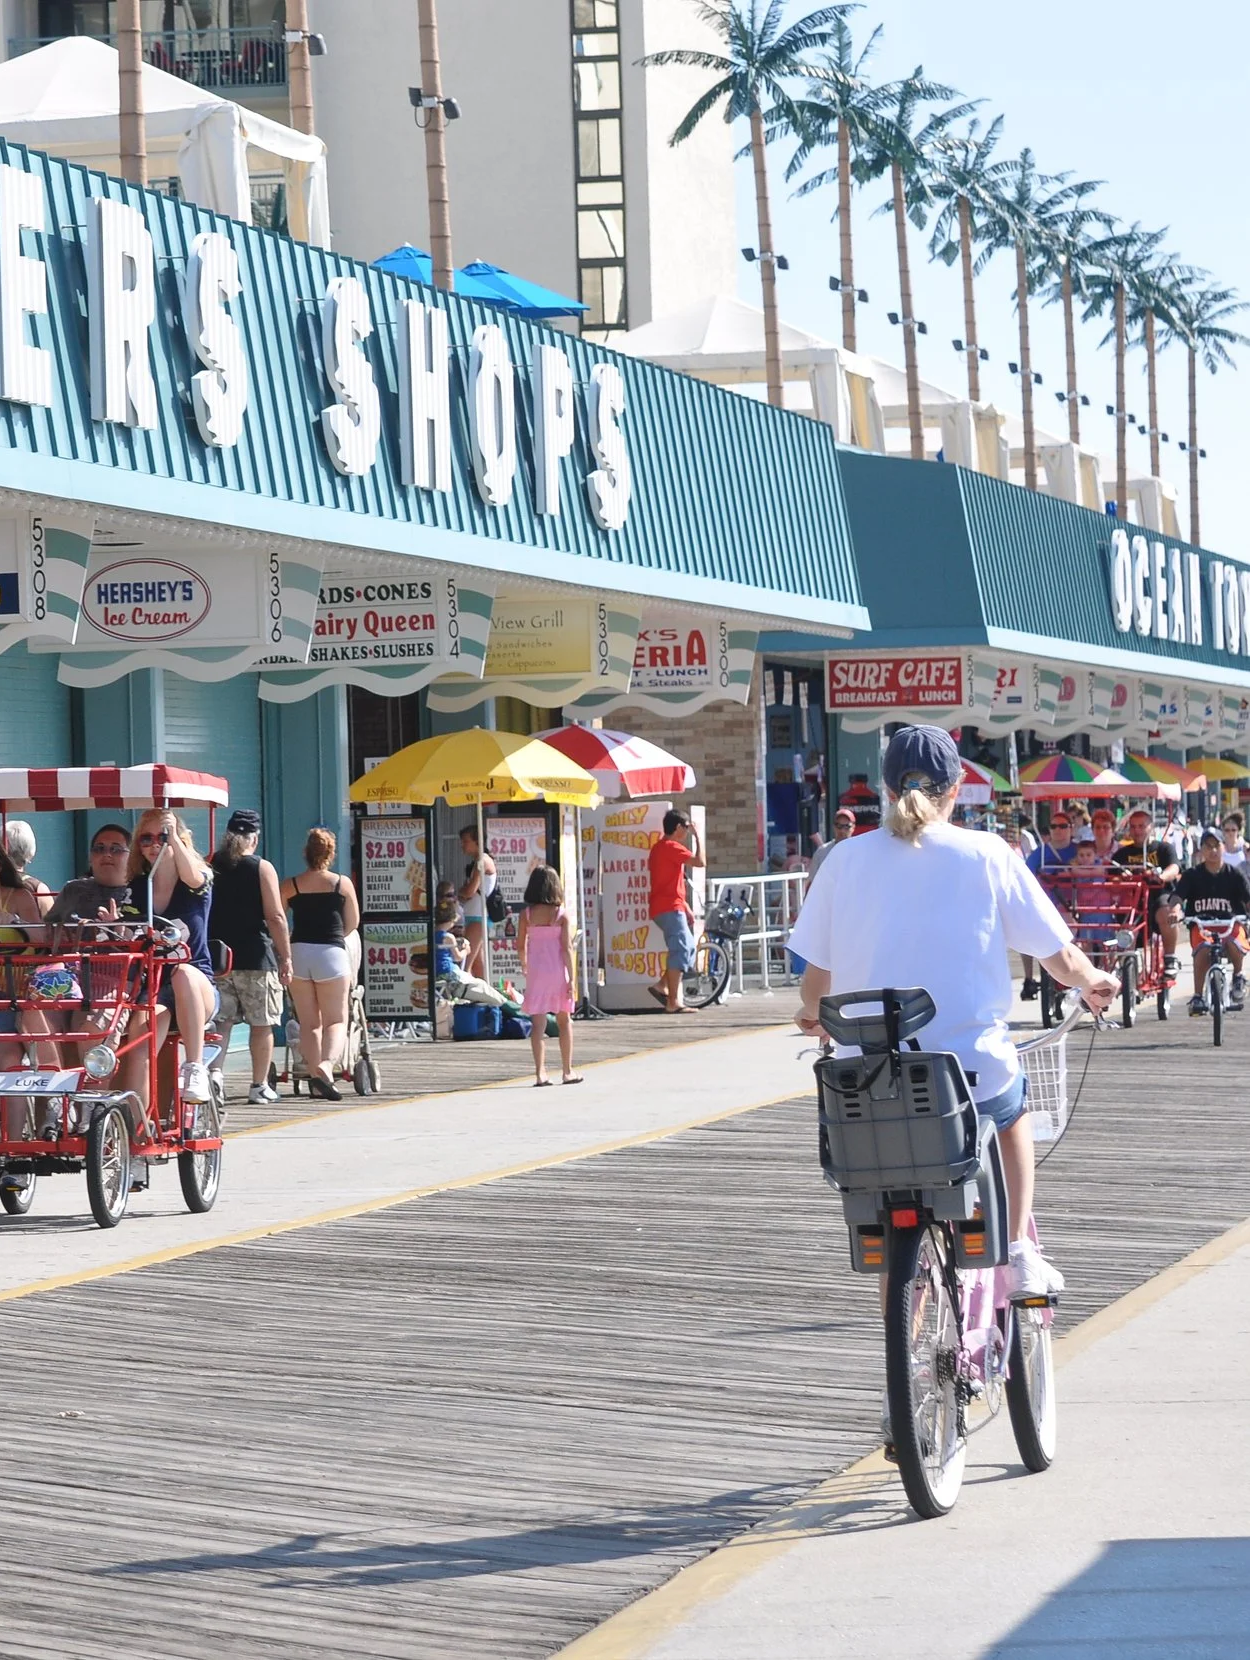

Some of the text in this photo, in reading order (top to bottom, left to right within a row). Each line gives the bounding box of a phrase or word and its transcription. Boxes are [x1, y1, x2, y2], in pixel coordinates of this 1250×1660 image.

[322, 277, 631, 531] SHOPS
[32, 517, 46, 620] 5308
[97, 580, 193, 605] HERSHEY'S
[363, 582, 432, 602] CONES
[1111, 529, 1203, 646] OCEAN
[269, 553, 282, 643] 5306
[103, 606, 191, 626] Ice Cream
[314, 611, 436, 640] airy Queen
[447, 579, 460, 659] 5304
[490, 610, 563, 629] View Grill
[496, 638, 552, 650] Sandwiches
[598, 603, 609, 676] 5302
[310, 646, 368, 661] SHAKES
[373, 643, 434, 659] SLUSHES
[719, 621, 729, 688] 5300
[656, 668, 708, 677] LUNCH
[832, 659, 958, 689] SURF CAFE
[648, 679, 693, 687] Steaks
[835, 690, 956, 704] BREAKFAST LUNCH
[363, 820, 424, 830] BREAKFAST
[488, 819, 543, 828] BREAKFAST
[605, 804, 649, 827] DAILY
[365, 840, 405, 859] $2.99
[491, 838, 527, 855] $2.99
[390, 860, 406, 868] EGGS
[603, 859, 635, 873] LARGE
[366, 883, 391, 891] WAFFLE
[627, 876, 647, 888] AND
[1194, 898, 1232, 912] GIANTS
[617, 909, 629, 922] OF
[366, 924, 424, 935] SANDWICH
[611, 925, 649, 951] ONLY
[368, 946, 407, 966] $4.95
[15, 1079, 49, 1087] LUKE
